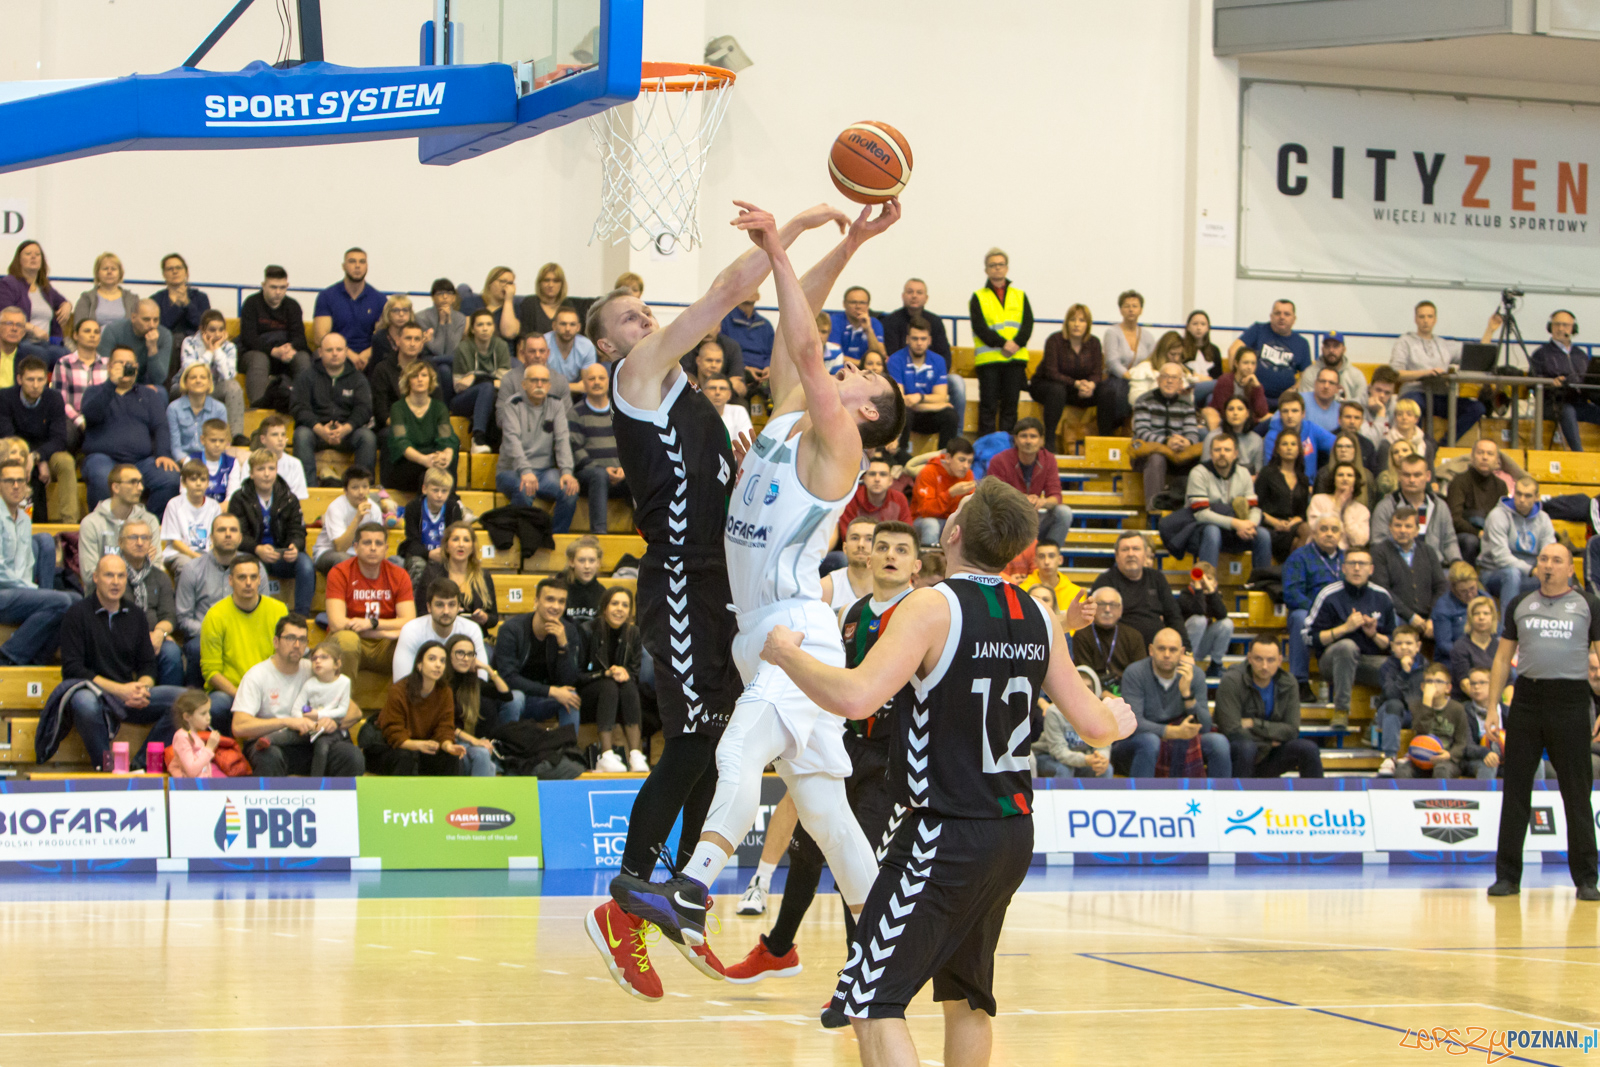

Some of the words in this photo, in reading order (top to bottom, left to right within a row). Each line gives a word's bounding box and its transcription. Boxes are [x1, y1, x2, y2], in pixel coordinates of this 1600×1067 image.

[205, 94, 314, 119] SPORT
[317, 82, 446, 122] SYSTEM
[847, 133, 891, 165] molten
[1276, 142, 1588, 215] CITYZEN
[3, 210, 24, 234] D
[1465, 214, 1502, 228] KLUB
[1509, 217, 1587, 233] SPORTOWY
[1525, 618, 1574, 631] VERONI
[1540, 630, 1572, 639] active
[971, 676, 1033, 774] 12
[244, 795, 316, 807] fundacja
[383, 809, 434, 827] Frytki
[450, 813, 478, 822] FARM
[480, 813, 512, 823] FRITES
[1263, 809, 1366, 827] funclub
[1425, 812, 1472, 825] JOKER
[246, 808, 317, 849] PBG
[1309, 828, 1366, 837] podróży
[39, 838, 98, 847] PRODUCENT
[103, 836, 136, 846] LEKÓW
